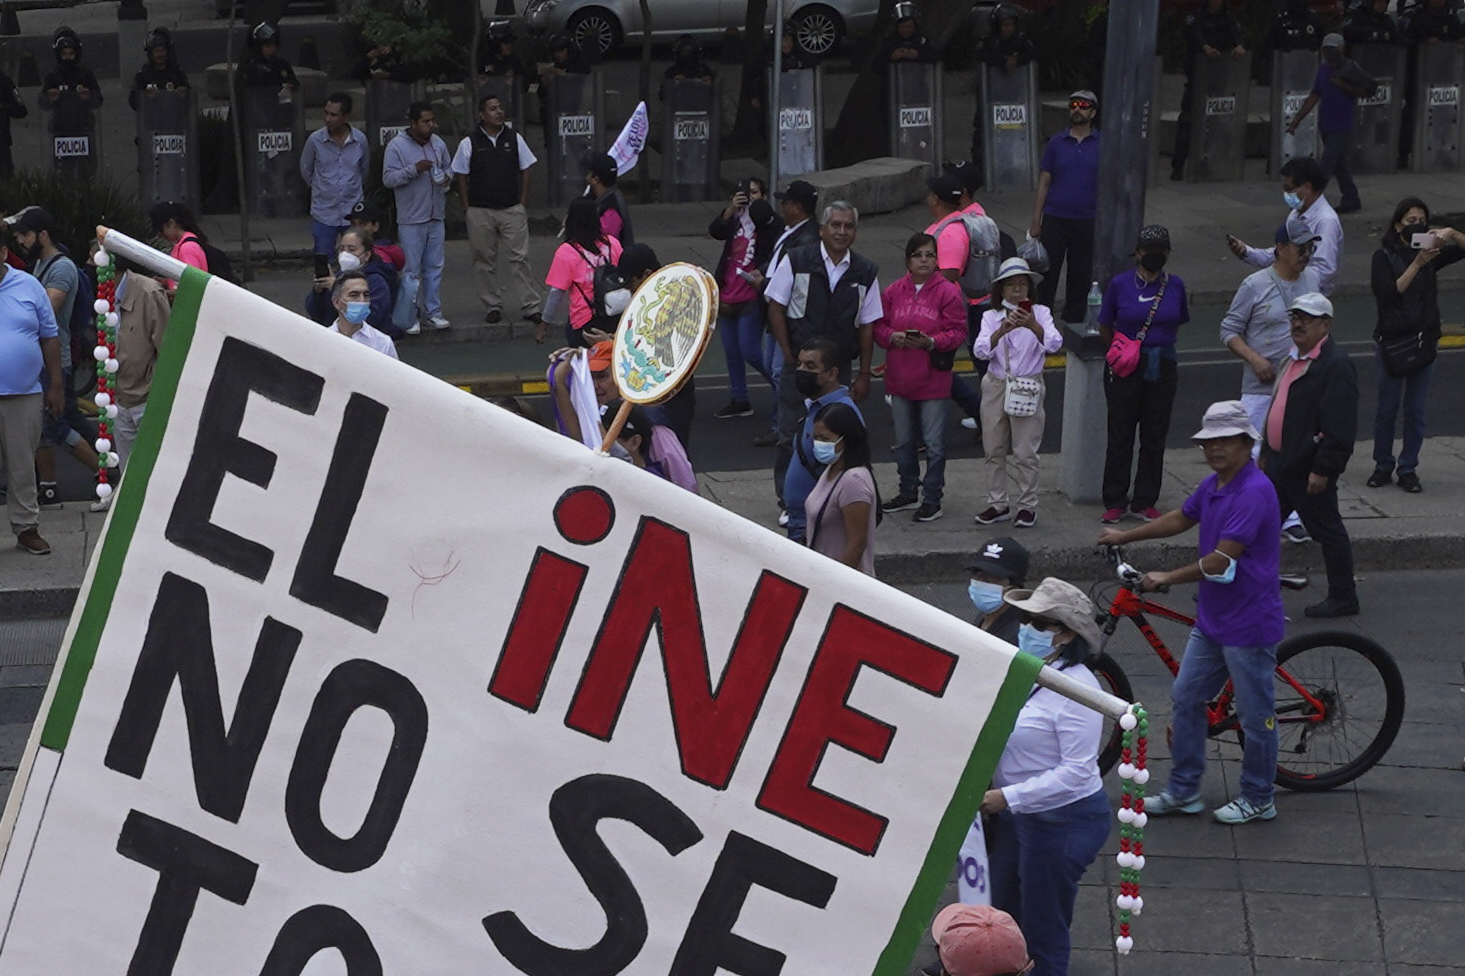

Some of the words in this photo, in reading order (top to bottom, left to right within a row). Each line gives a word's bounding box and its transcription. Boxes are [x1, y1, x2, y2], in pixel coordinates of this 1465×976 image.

[1429, 89, 1457, 103] POLICIA
[1207, 100, 1234, 113] POLICIA
[780, 111, 810, 128] POLICIA
[901, 110, 930, 125] POLICIA
[995, 107, 1024, 122] POLICIA
[562, 118, 590, 132] POLICIA
[677, 123, 706, 138] POLICIA
[56, 140, 86, 154] POLICIA
[154, 138, 183, 151] POLICIA
[260, 136, 290, 149] POLICIA
[165, 336, 390, 633] EL
[104, 572, 429, 873] NO
